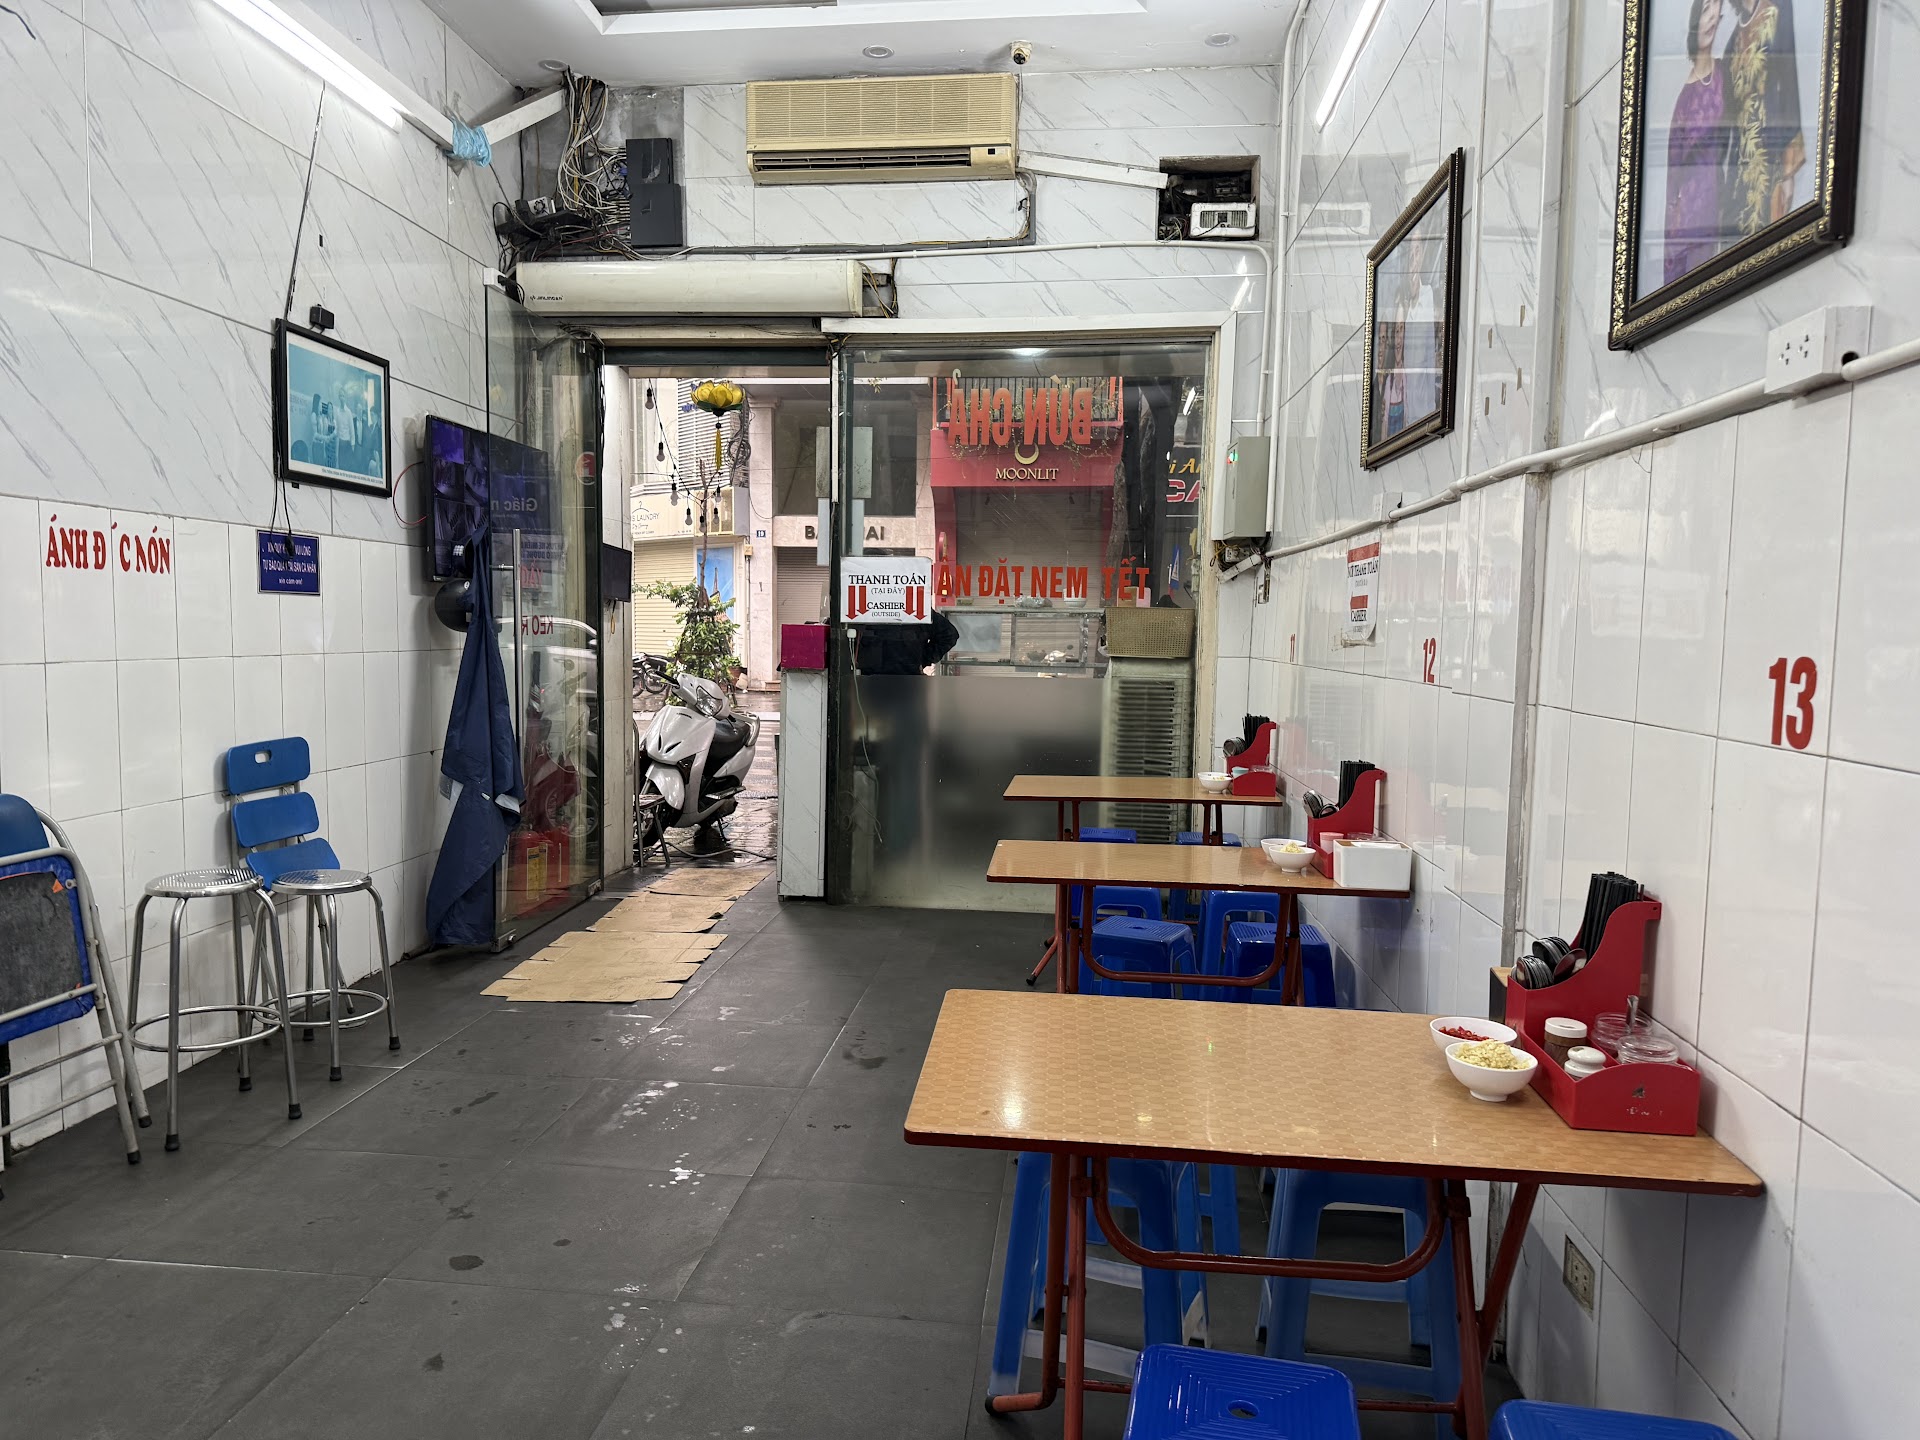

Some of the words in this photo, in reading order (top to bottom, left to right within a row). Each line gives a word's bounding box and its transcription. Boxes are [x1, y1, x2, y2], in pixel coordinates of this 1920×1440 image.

[995, 467, 1059, 481] MOONLIT
[636, 512, 660, 522] LAUNDRY
[46, 514, 89, 569] ÁNH
[848, 574, 890, 585] THANH
[893, 572, 926, 585] TOÁN
[931, 556, 972, 602] ẬN
[978, 557, 1025, 604] ĐẶT
[1030, 566, 1088, 599] NEM
[1100, 556, 1150, 600] TẾT
[871, 587, 886, 595] (TẠI
[866, 601, 906, 610] CASHIER
[1423, 637, 1437, 684] 12
[1768, 656, 1818, 750] 13
